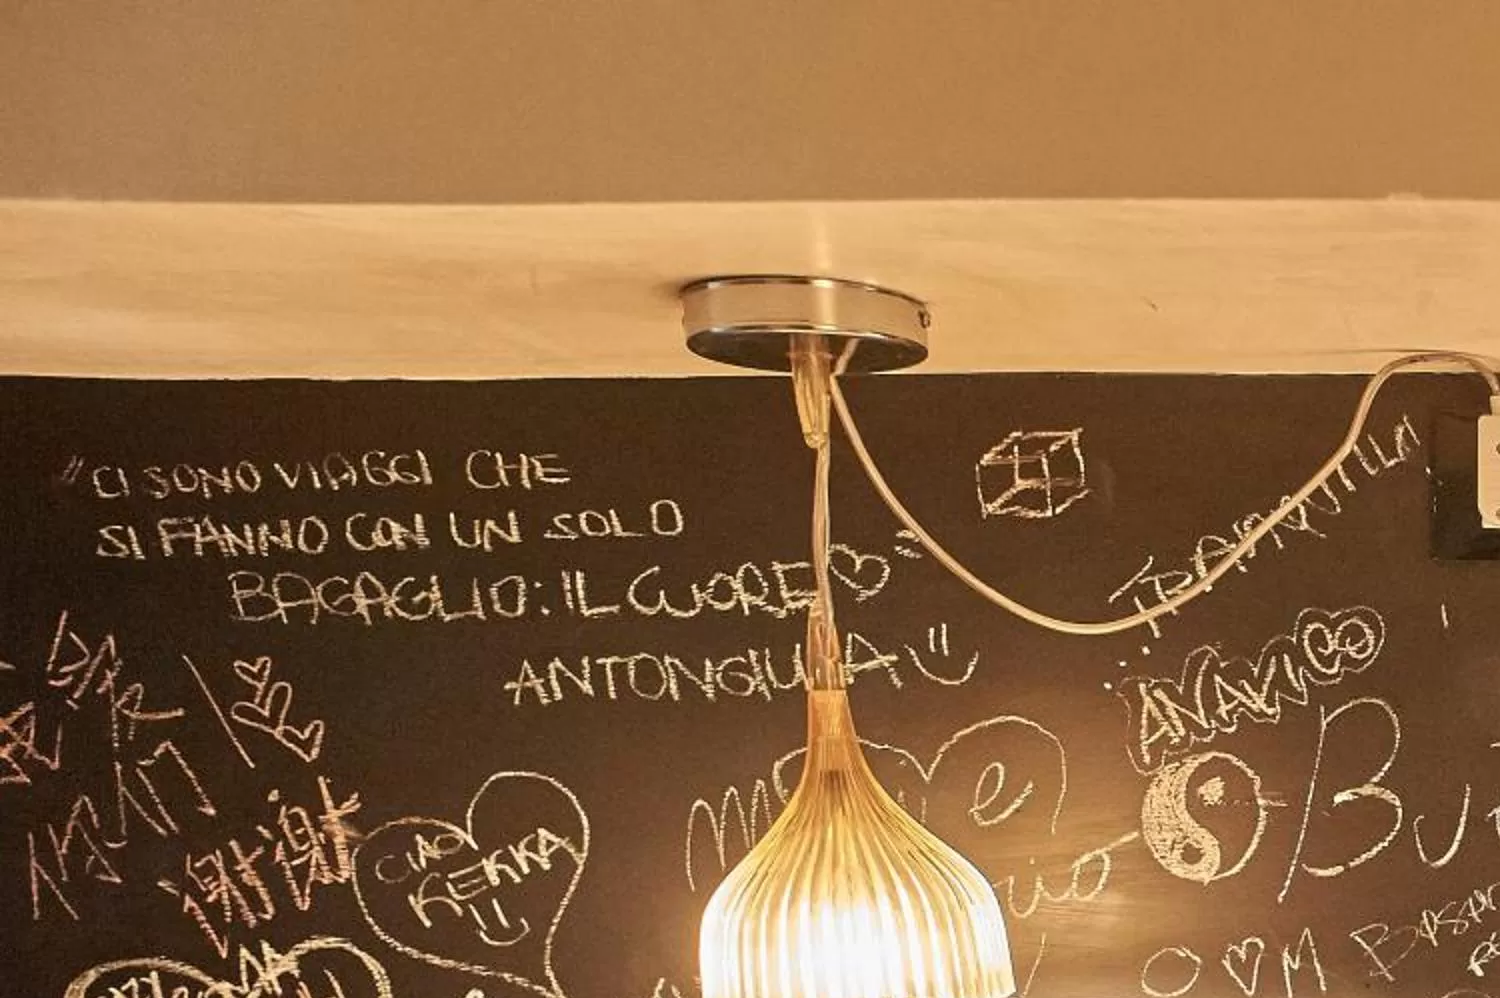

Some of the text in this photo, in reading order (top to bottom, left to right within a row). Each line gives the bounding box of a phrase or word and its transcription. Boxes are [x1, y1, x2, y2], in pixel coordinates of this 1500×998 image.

[148, 459, 261, 500] SONO
[272, 449, 434, 491] VIAGGI
[465, 448, 573, 491] CHE
[97, 523, 146, 560] SI
[158, 514, 329, 557] FANNO
[448, 509, 522, 551] UN
[543, 498, 685, 540] SOLO
[562, 569, 621, 618] IL
[626, 559, 819, 620] CUORE
